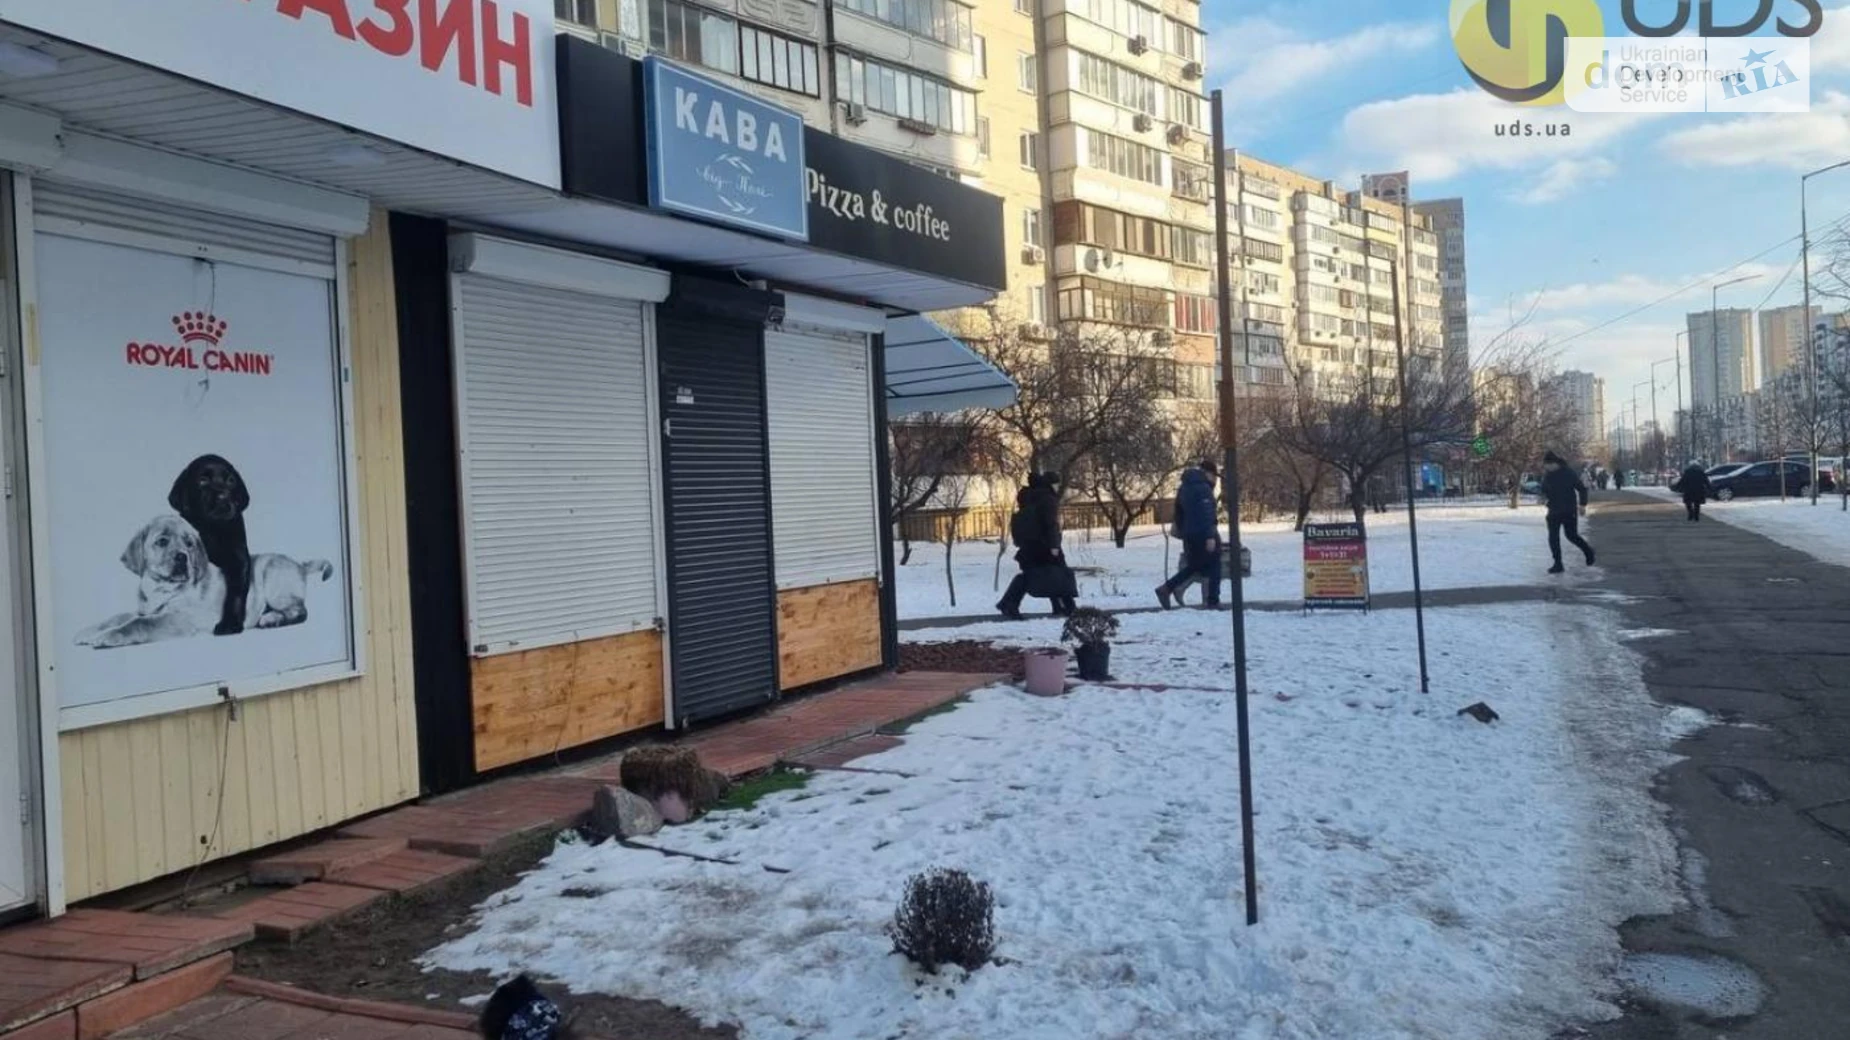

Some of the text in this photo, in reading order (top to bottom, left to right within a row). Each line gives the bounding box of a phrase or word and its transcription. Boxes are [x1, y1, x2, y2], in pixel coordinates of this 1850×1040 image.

[675, 86, 787, 163] КАВА
[805, 167, 865, 219] Pizza
[871, 189, 890, 226] &
[894, 201, 951, 241] coffee
[126, 342, 270, 375] ROYAL CANIN
[1307, 526, 1359, 537] Bavaria
